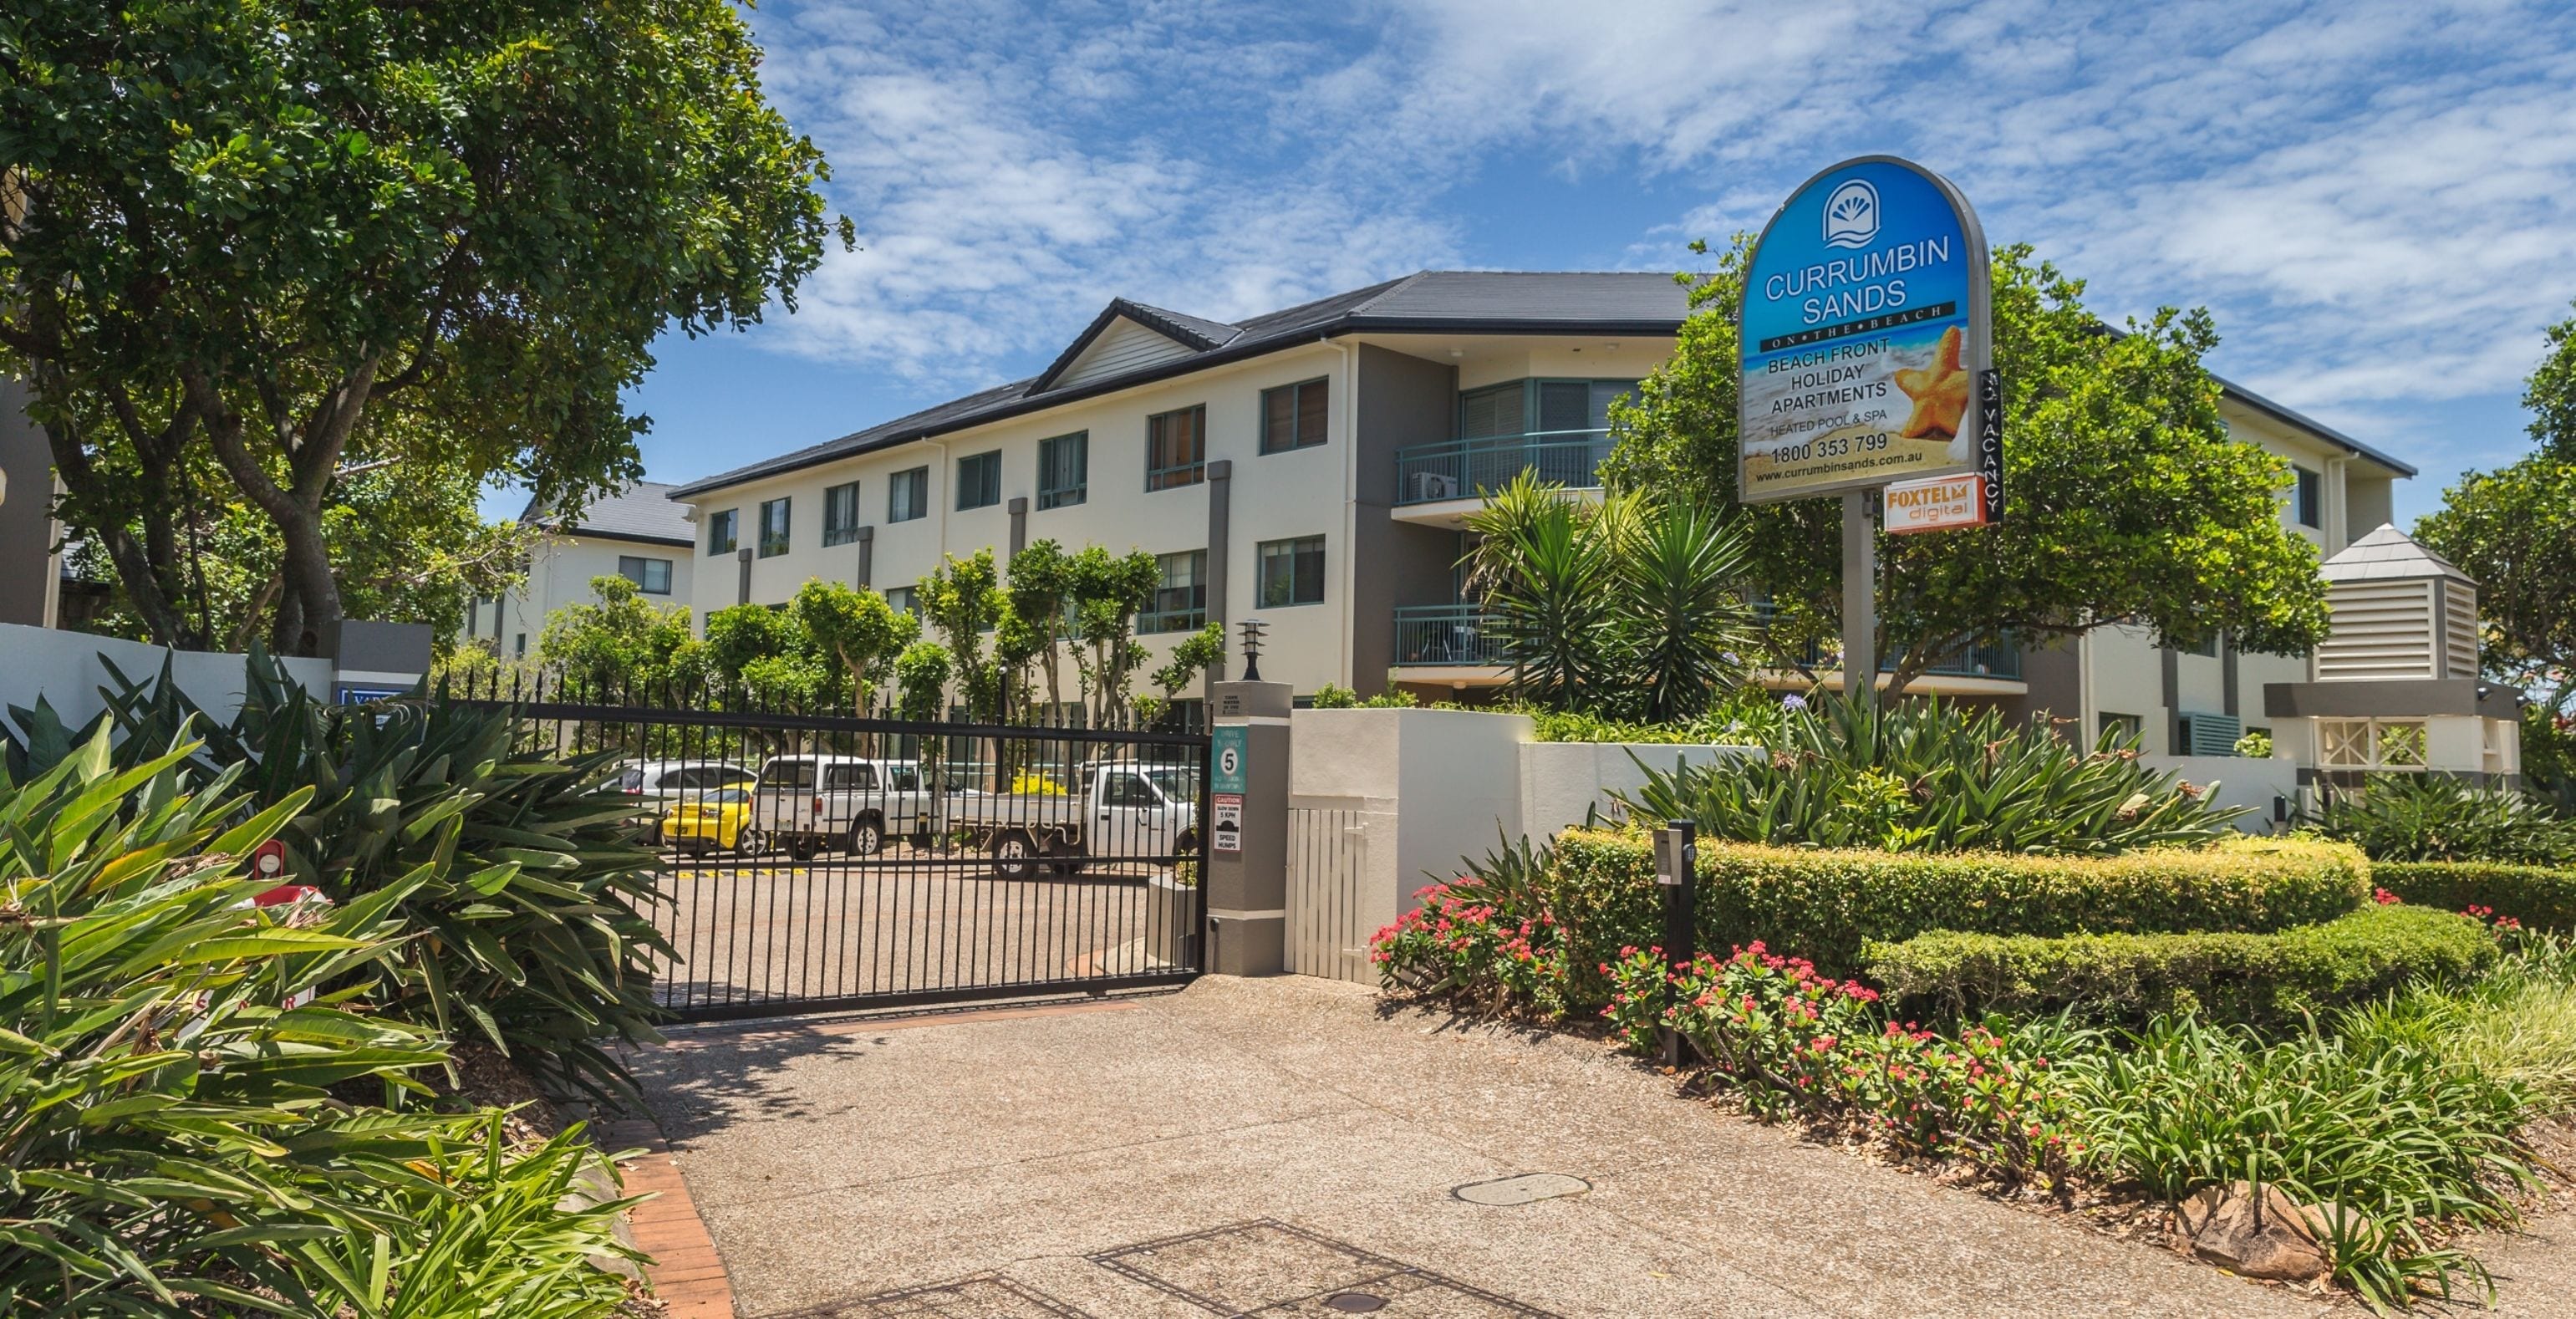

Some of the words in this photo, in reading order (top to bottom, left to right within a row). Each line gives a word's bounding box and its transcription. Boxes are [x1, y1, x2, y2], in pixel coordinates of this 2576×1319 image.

[1765, 235, 1948, 301] CURRUMBIN
[1802, 279, 1907, 324] SANDS
[1768, 350, 1825, 374] BEACH
[1830, 338, 1890, 362] FRONT
[1791, 364, 1865, 390] HOLIDAY
[1771, 382, 1886, 415] APARTMENTS
[1770, 420, 1815, 436] HEATED
[1818, 415, 1850, 430] POOL
[1852, 414, 1861, 424] &
[1864, 410, 1887, 422] SPA
[1771, 444, 1811, 464] 1800
[1817, 438, 1848, 458] 353
[1855, 433, 1887, 452] 799
[1983, 409, 2000, 513] VACANCY
[1756, 451, 1922, 482] www.currumbinsands.com.au
[1887, 486, 1950, 508] FOXTEL
[1909, 502, 1967, 521] digital
[1224, 753, 1234, 771] 5
